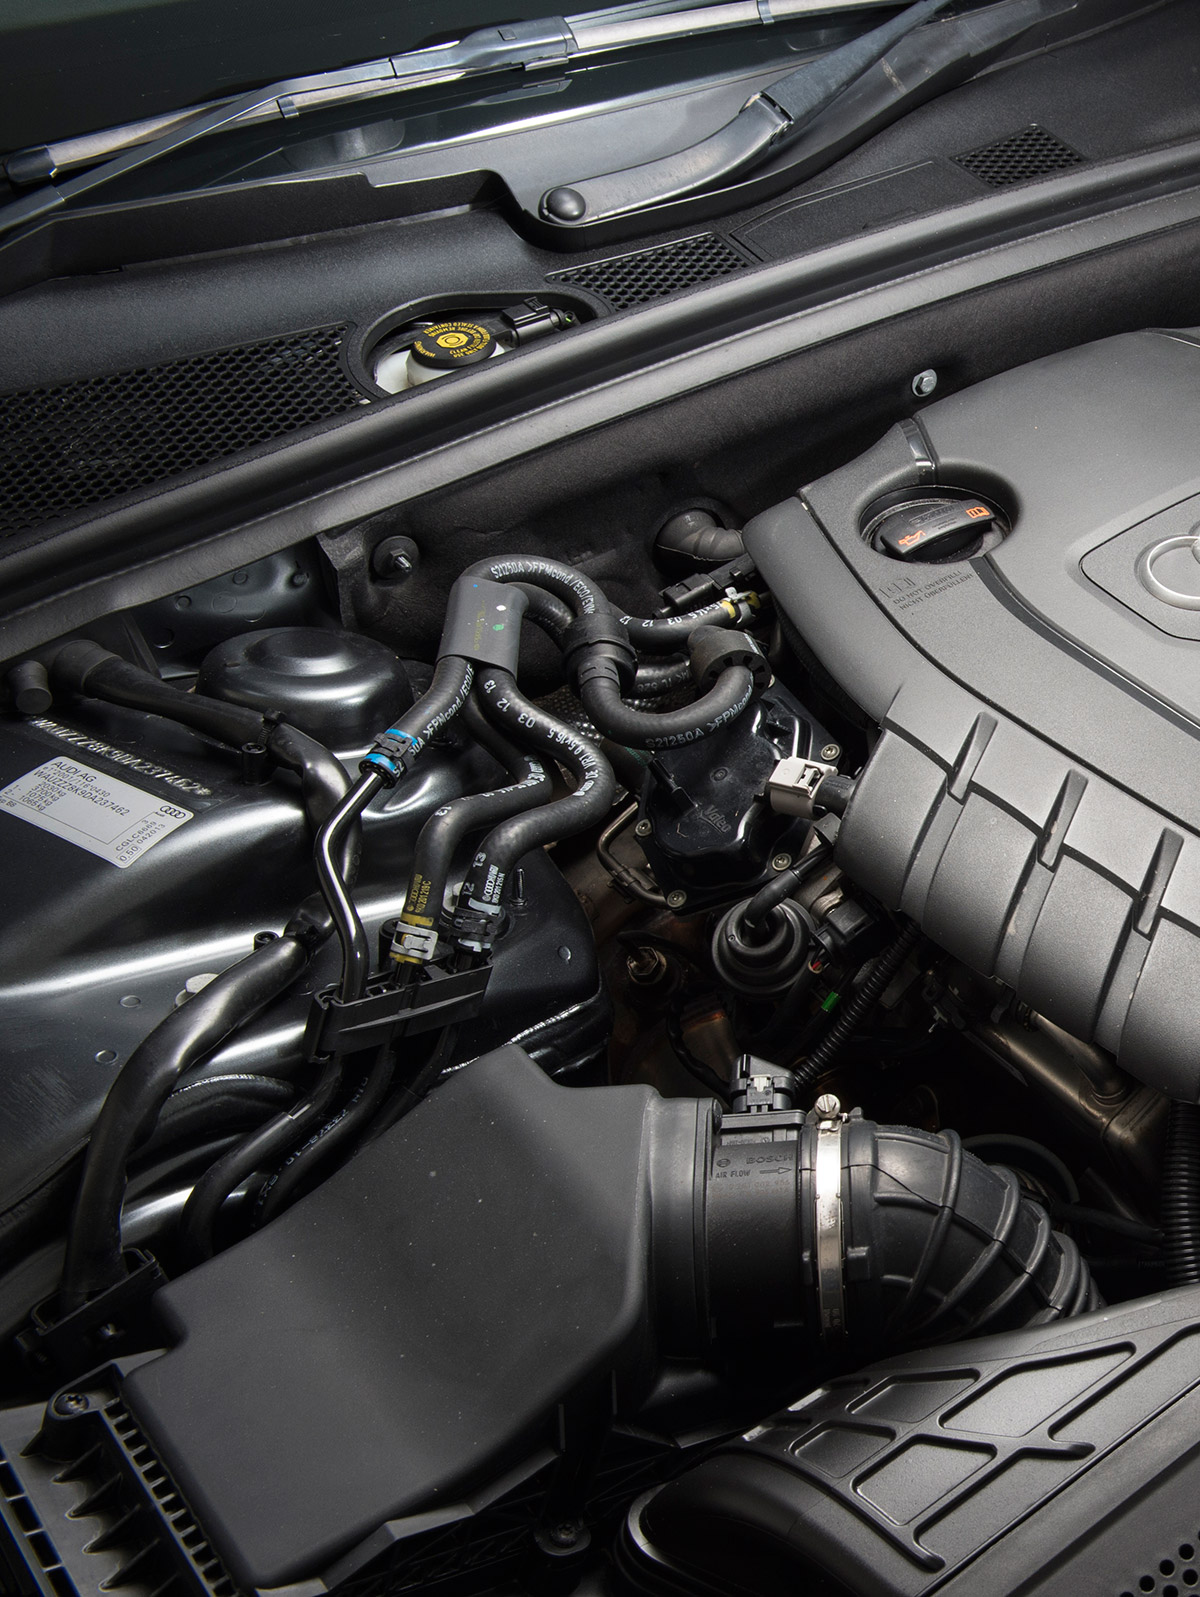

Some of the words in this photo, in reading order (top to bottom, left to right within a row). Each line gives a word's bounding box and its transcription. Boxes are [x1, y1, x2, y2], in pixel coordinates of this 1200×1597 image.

[51, 761, 82, 776] AUDI
[78, 772, 97, 783] AG
[33, 769, 130, 817] WAUZZZ8K9DA237462
[704, 804, 732, 833] Valeo
[745, 1153, 794, 1165] BOSCH
[715, 1171, 728, 1179] AIR
[730, 1169, 751, 1178] FLOW
